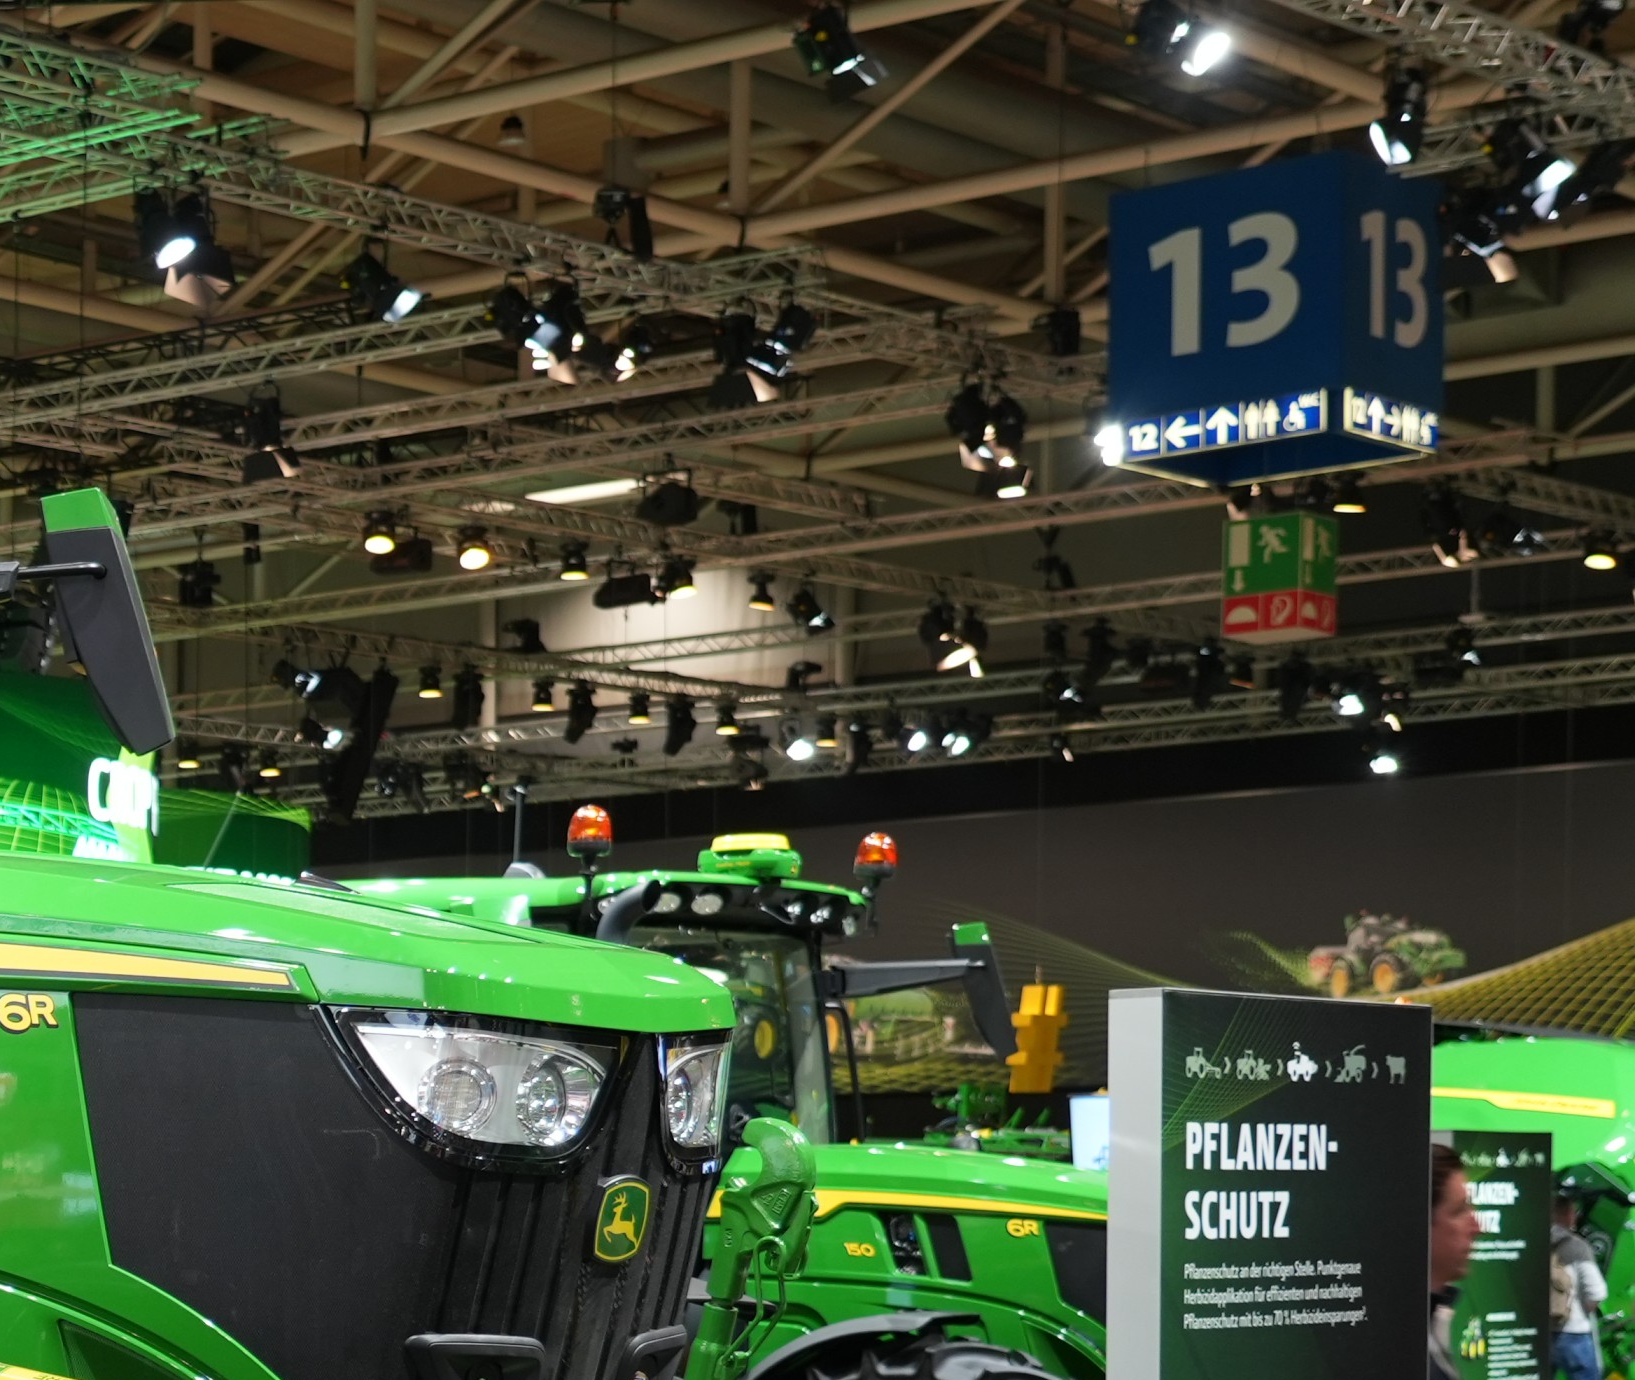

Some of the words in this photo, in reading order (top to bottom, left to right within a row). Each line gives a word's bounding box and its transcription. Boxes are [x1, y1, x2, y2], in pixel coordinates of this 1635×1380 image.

[1148, 211, 1300, 357] 13
[1360, 209, 1428, 349] 13
[1128, 423, 1159, 452] 12
[1185, 1121, 1339, 1173] PFLANZEN-
[1006, 1218, 1040, 1238] 6R
[1184, 1190, 1291, 1241] SCHUTZ
[843, 1241, 876, 1258] 150
[1184, 1262, 1239, 1279] Pflanzenschutz
[1250, 1262, 1262, 1278] der
[1263, 1261, 1294, 1282] richtigen
[1317, 1259, 1362, 1280] Punktgenaue
[1183, 1312, 1239, 1330] Pflanzenschutz
